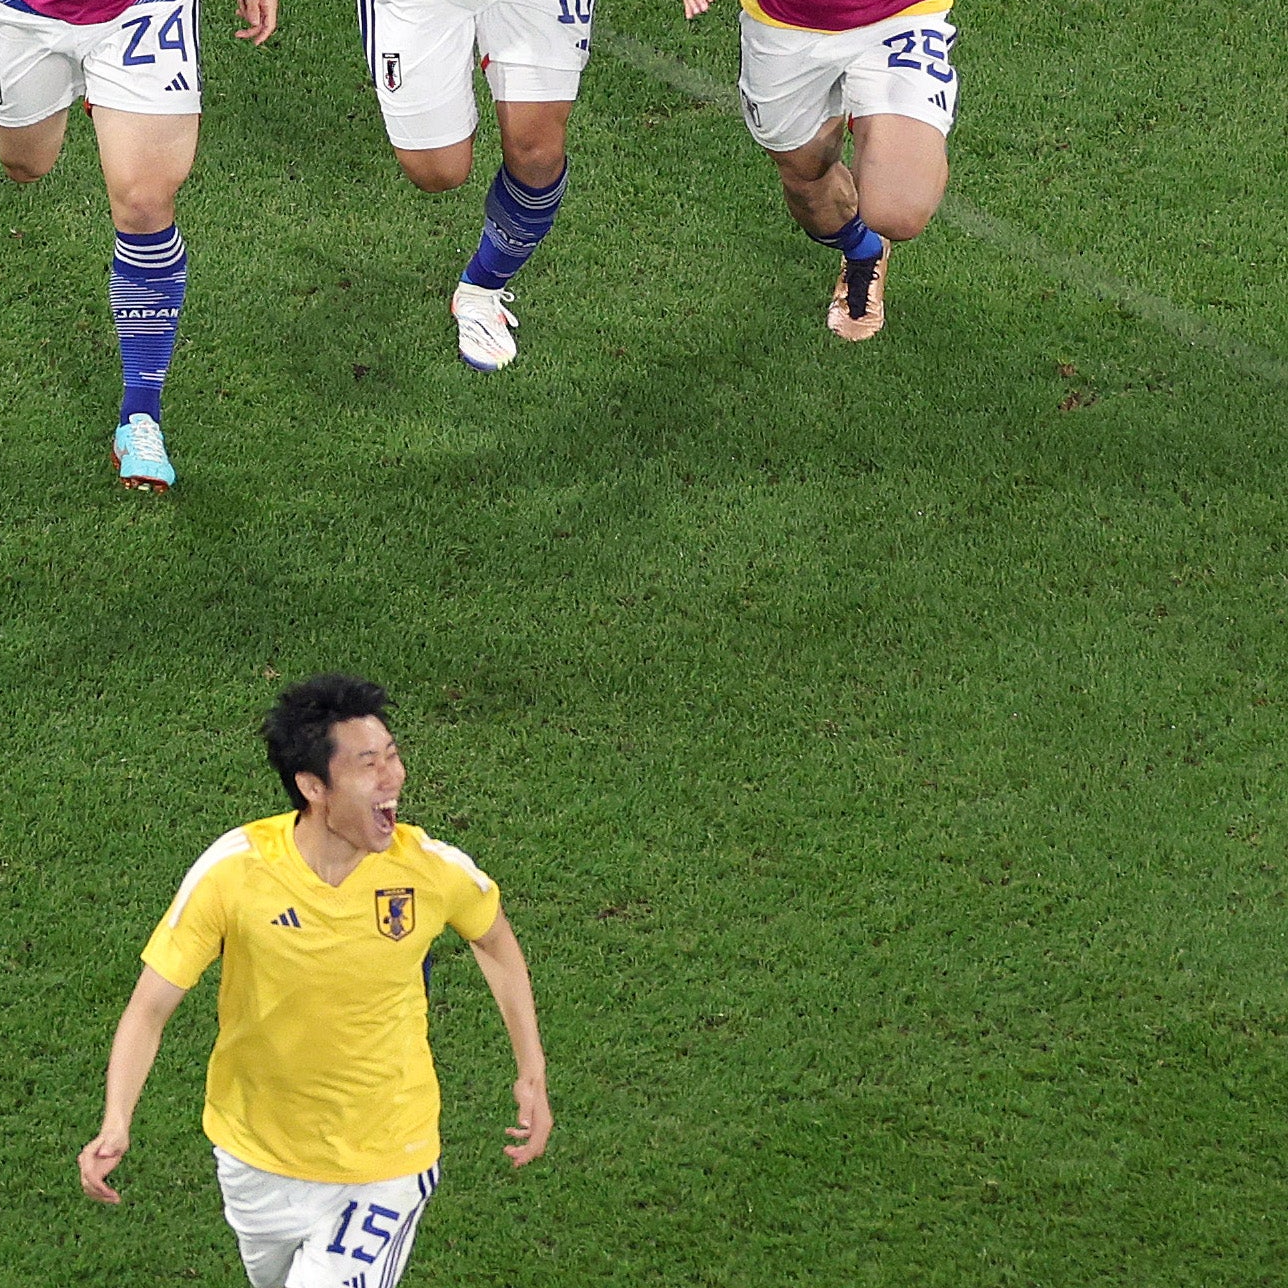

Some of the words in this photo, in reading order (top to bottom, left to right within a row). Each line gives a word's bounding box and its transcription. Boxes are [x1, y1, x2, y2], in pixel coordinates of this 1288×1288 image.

[121, 4, 188, 67] 24
[882, 28, 954, 85] 25
[117, 308, 180, 319] JAPAN
[326, 1199, 400, 1265] 15
